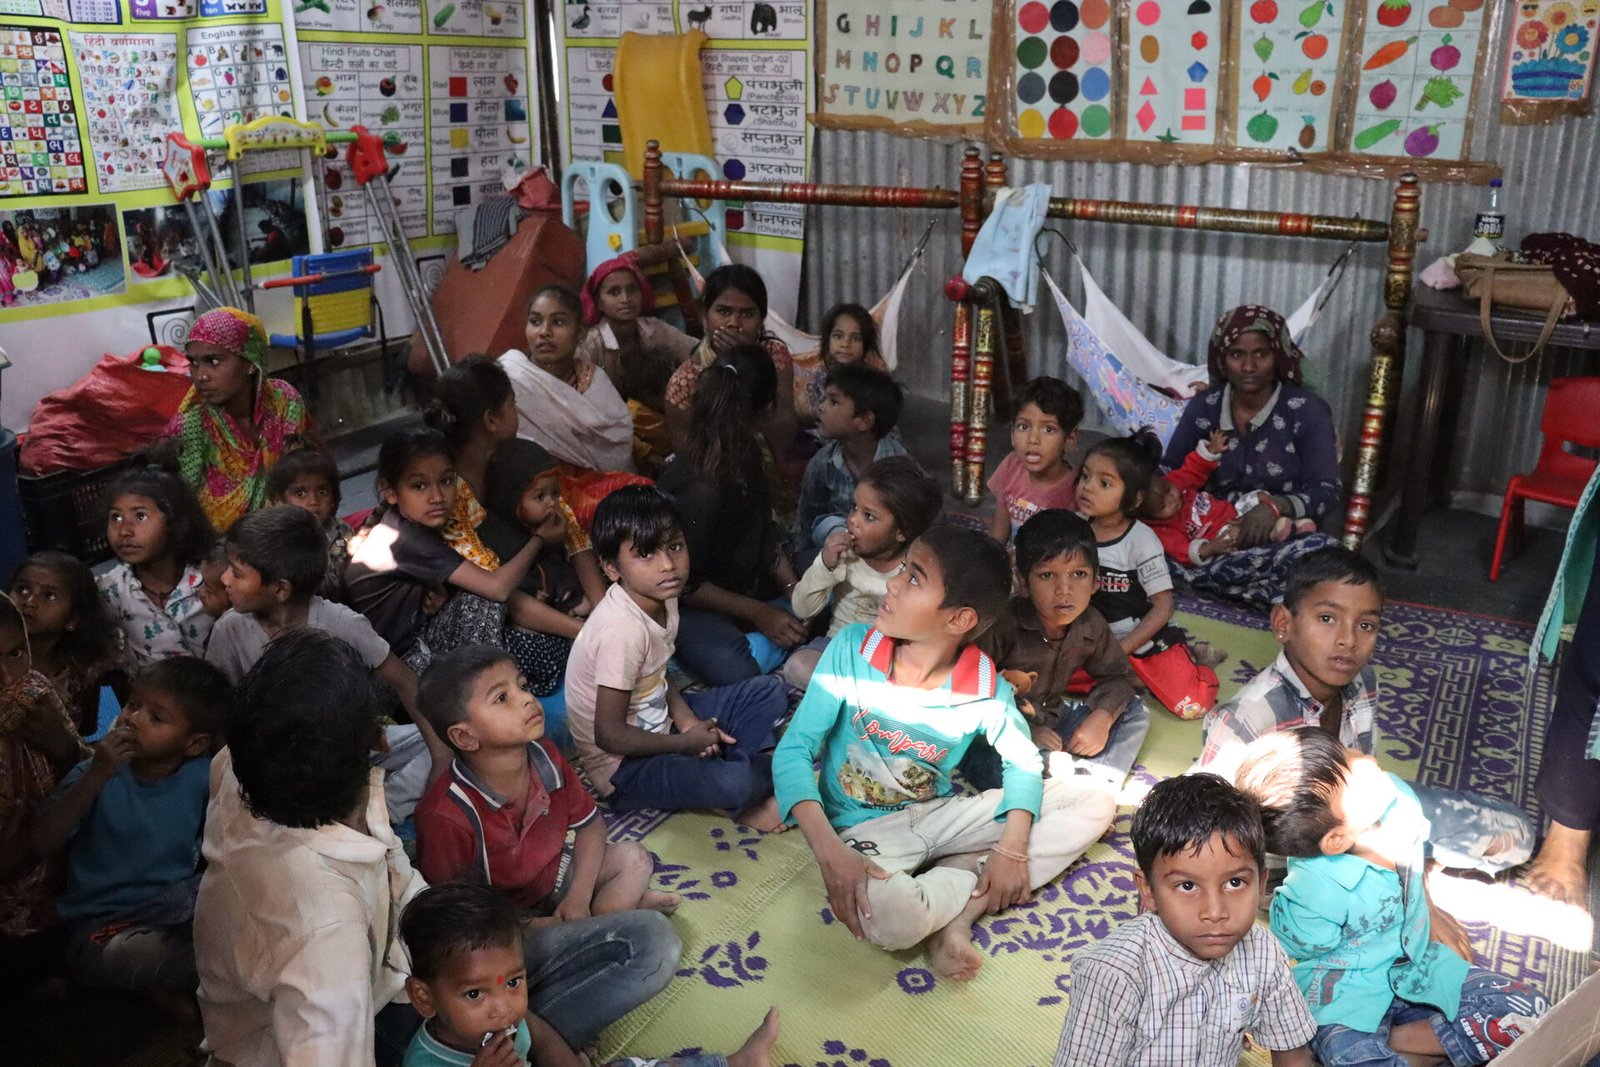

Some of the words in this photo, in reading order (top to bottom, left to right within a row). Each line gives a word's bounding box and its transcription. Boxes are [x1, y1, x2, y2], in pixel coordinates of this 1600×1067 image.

[135, 8, 151, 16] five
[837, 13, 851, 34] G
[865, 14, 881, 37] H
[891, 15, 898, 37] I
[909, 16, 925, 38] J
[938, 17, 957, 39] K
[968, 18, 984, 40] L
[84, 35, 106, 46] हिंदी
[110, 35, 155, 46] वर्णमाला
[201, 29, 237, 40] English
[322, 47, 345, 57] Hindi
[347, 48, 371, 57] Fruits
[373, 48, 397, 58] Chart
[721, 54, 750, 63] Shapes
[751, 54, 774, 62] Chart
[835, 48, 852, 70] M
[862, 51, 879, 73] N
[884, 52, 902, 74] O
[909, 53, 923, 74] P
[935, 55, 956, 79] Q
[966, 56, 982, 79] R
[473, 76, 497, 87] लाल
[823, 83, 841, 104] S
[844, 84, 861, 106] T
[865, 87, 881, 110] U
[885, 89, 899, 111] V
[902, 89, 925, 112] W
[932, 91, 951, 114] X
[952, 93, 967, 116] Y
[971, 94, 986, 117] Z
[474, 100, 500, 113] नीला
[571, 102, 597, 111] Triangle
[475, 126, 499, 138] पीला
[481, 155, 499, 168] हरा
[1472, 1011, 1485, 1024] US
[1460, 1018, 1474, 1037] LESS
